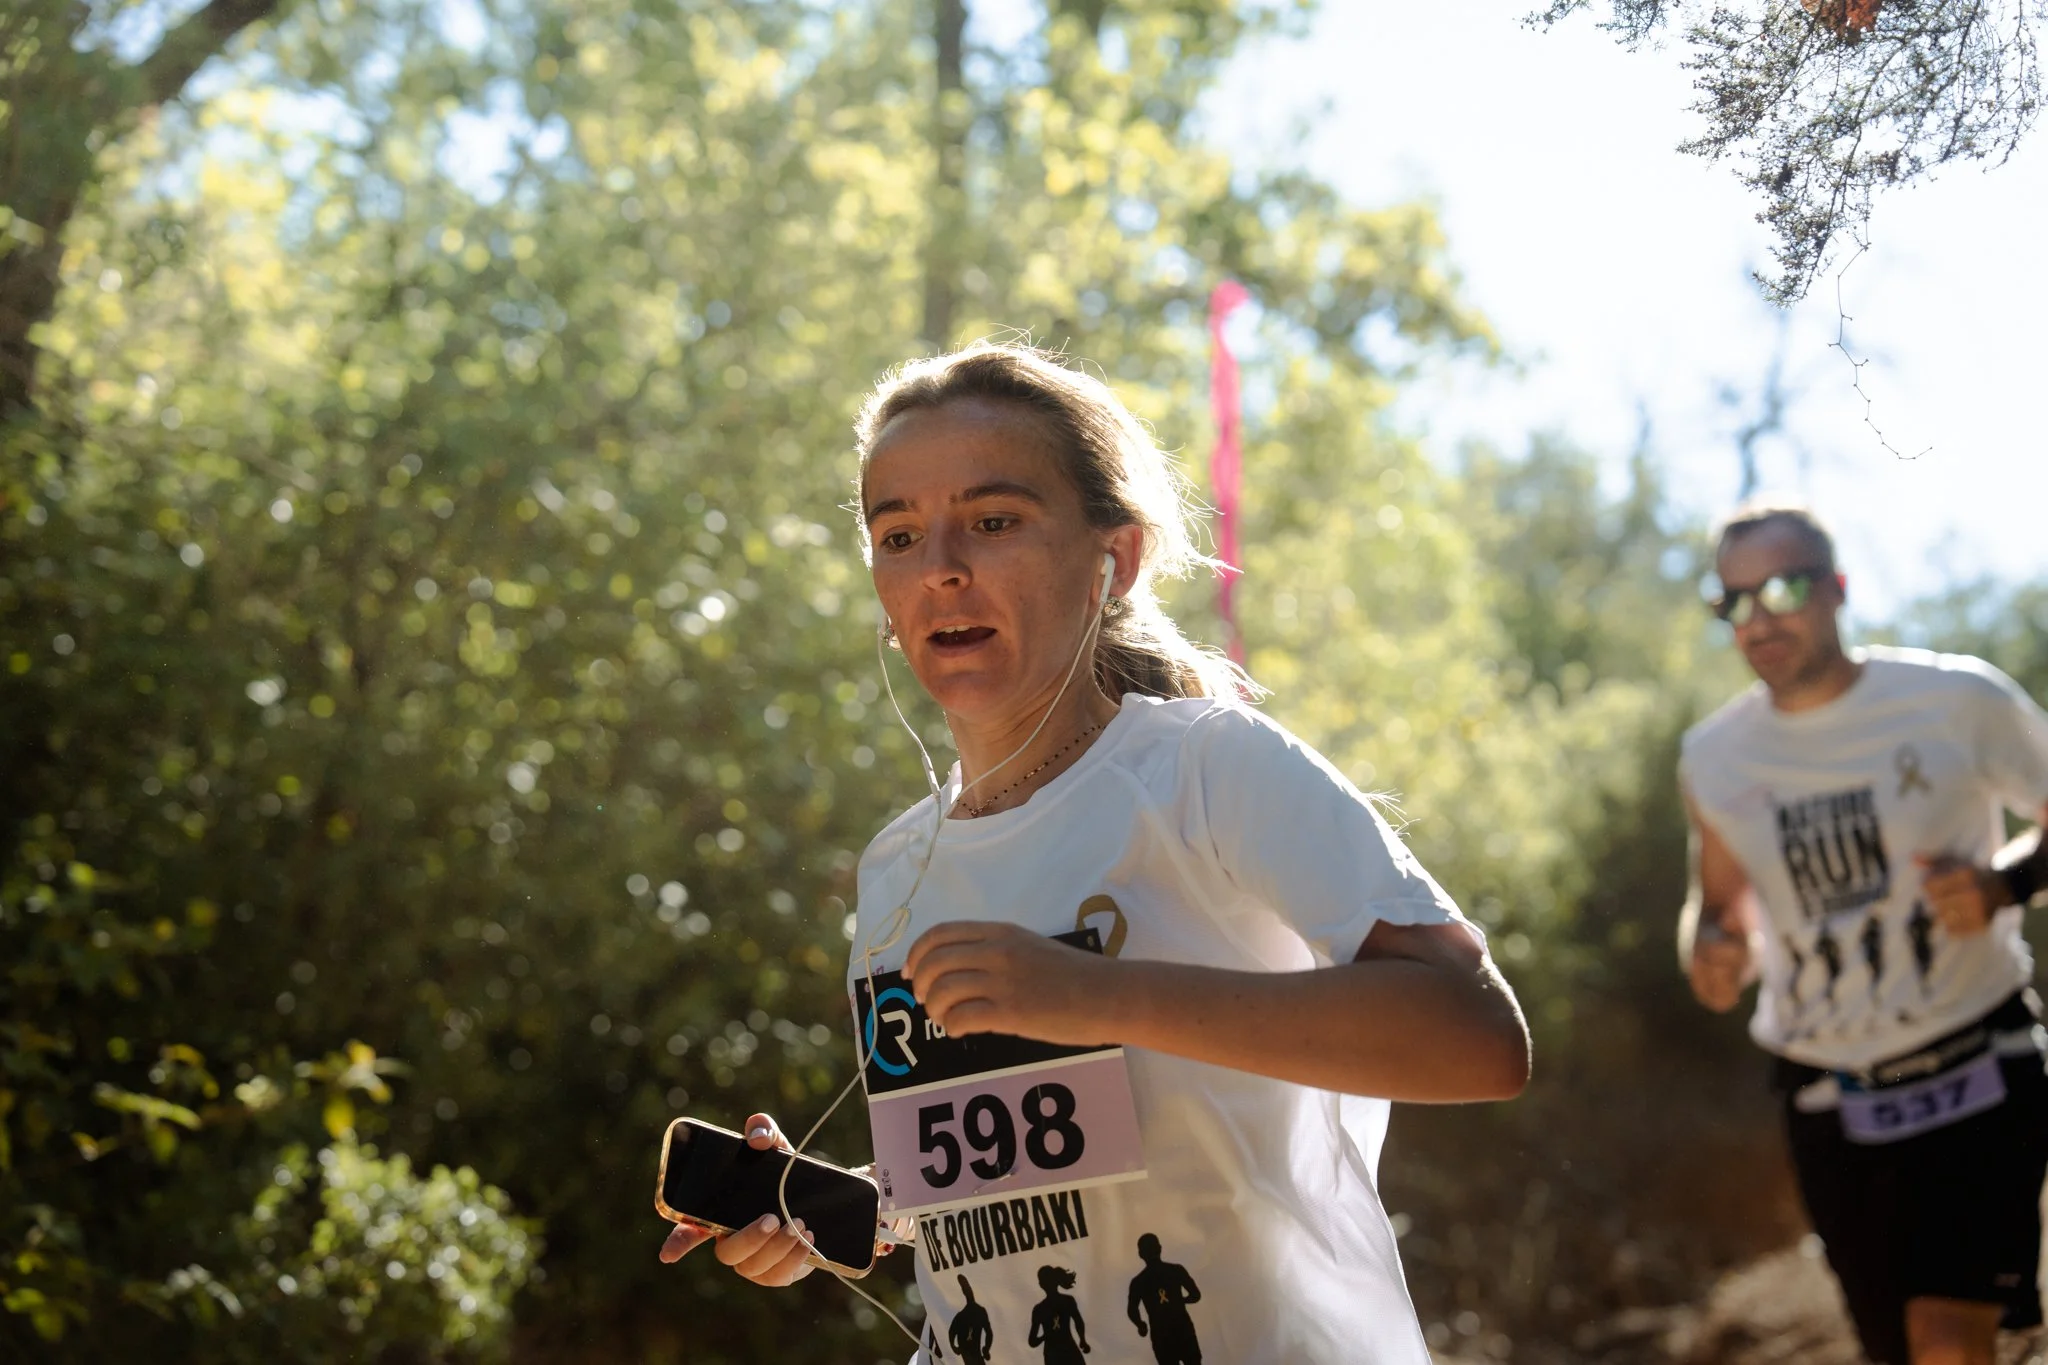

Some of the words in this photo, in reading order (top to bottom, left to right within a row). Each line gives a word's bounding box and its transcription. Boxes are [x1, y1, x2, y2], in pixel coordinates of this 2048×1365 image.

[1782, 812, 1889, 894] RUN
[918, 1082, 1085, 1189] 598
[920, 1216, 950, 1273] DE
[943, 1189, 1089, 1269] BOURBAKI
